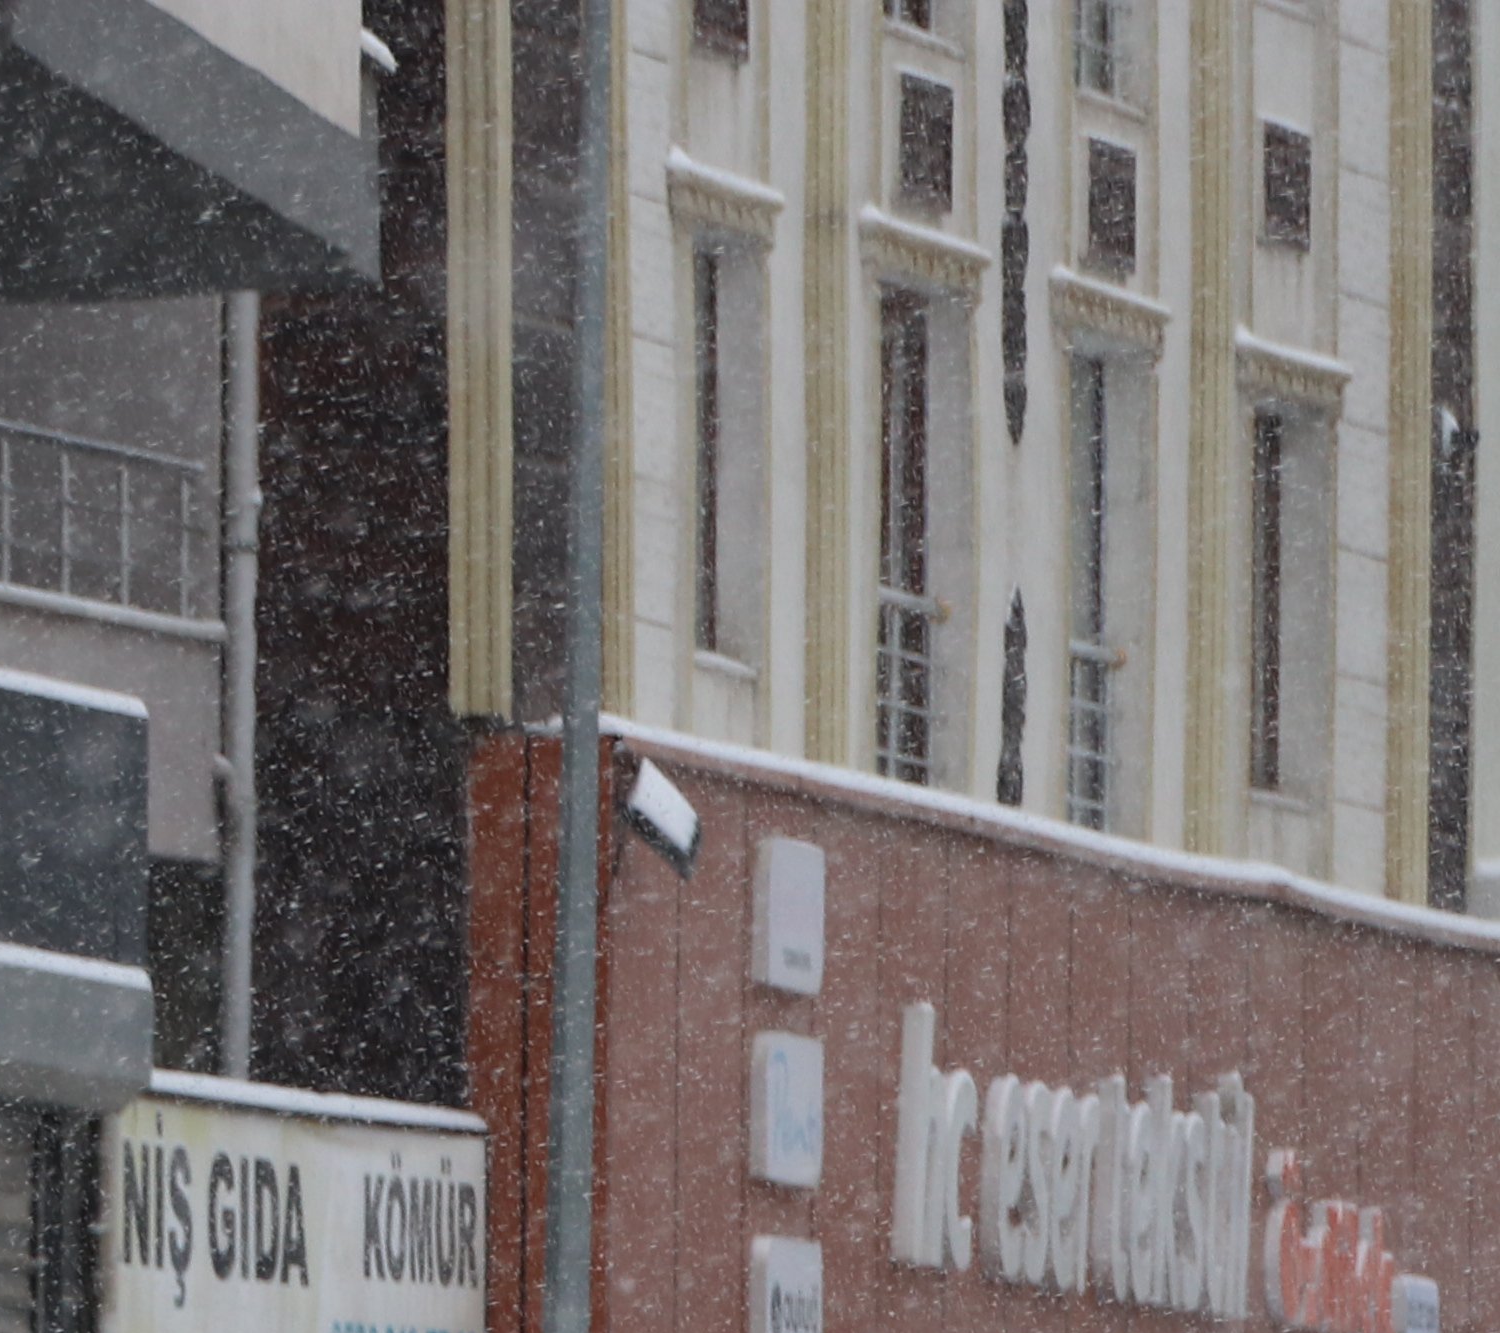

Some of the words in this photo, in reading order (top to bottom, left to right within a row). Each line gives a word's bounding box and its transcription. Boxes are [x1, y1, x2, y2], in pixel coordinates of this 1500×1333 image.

[123, 1110, 192, 1308] NİŞ
[208, 1151, 309, 1287] GIDA
[363, 1152, 479, 1289] KÖMÜR
